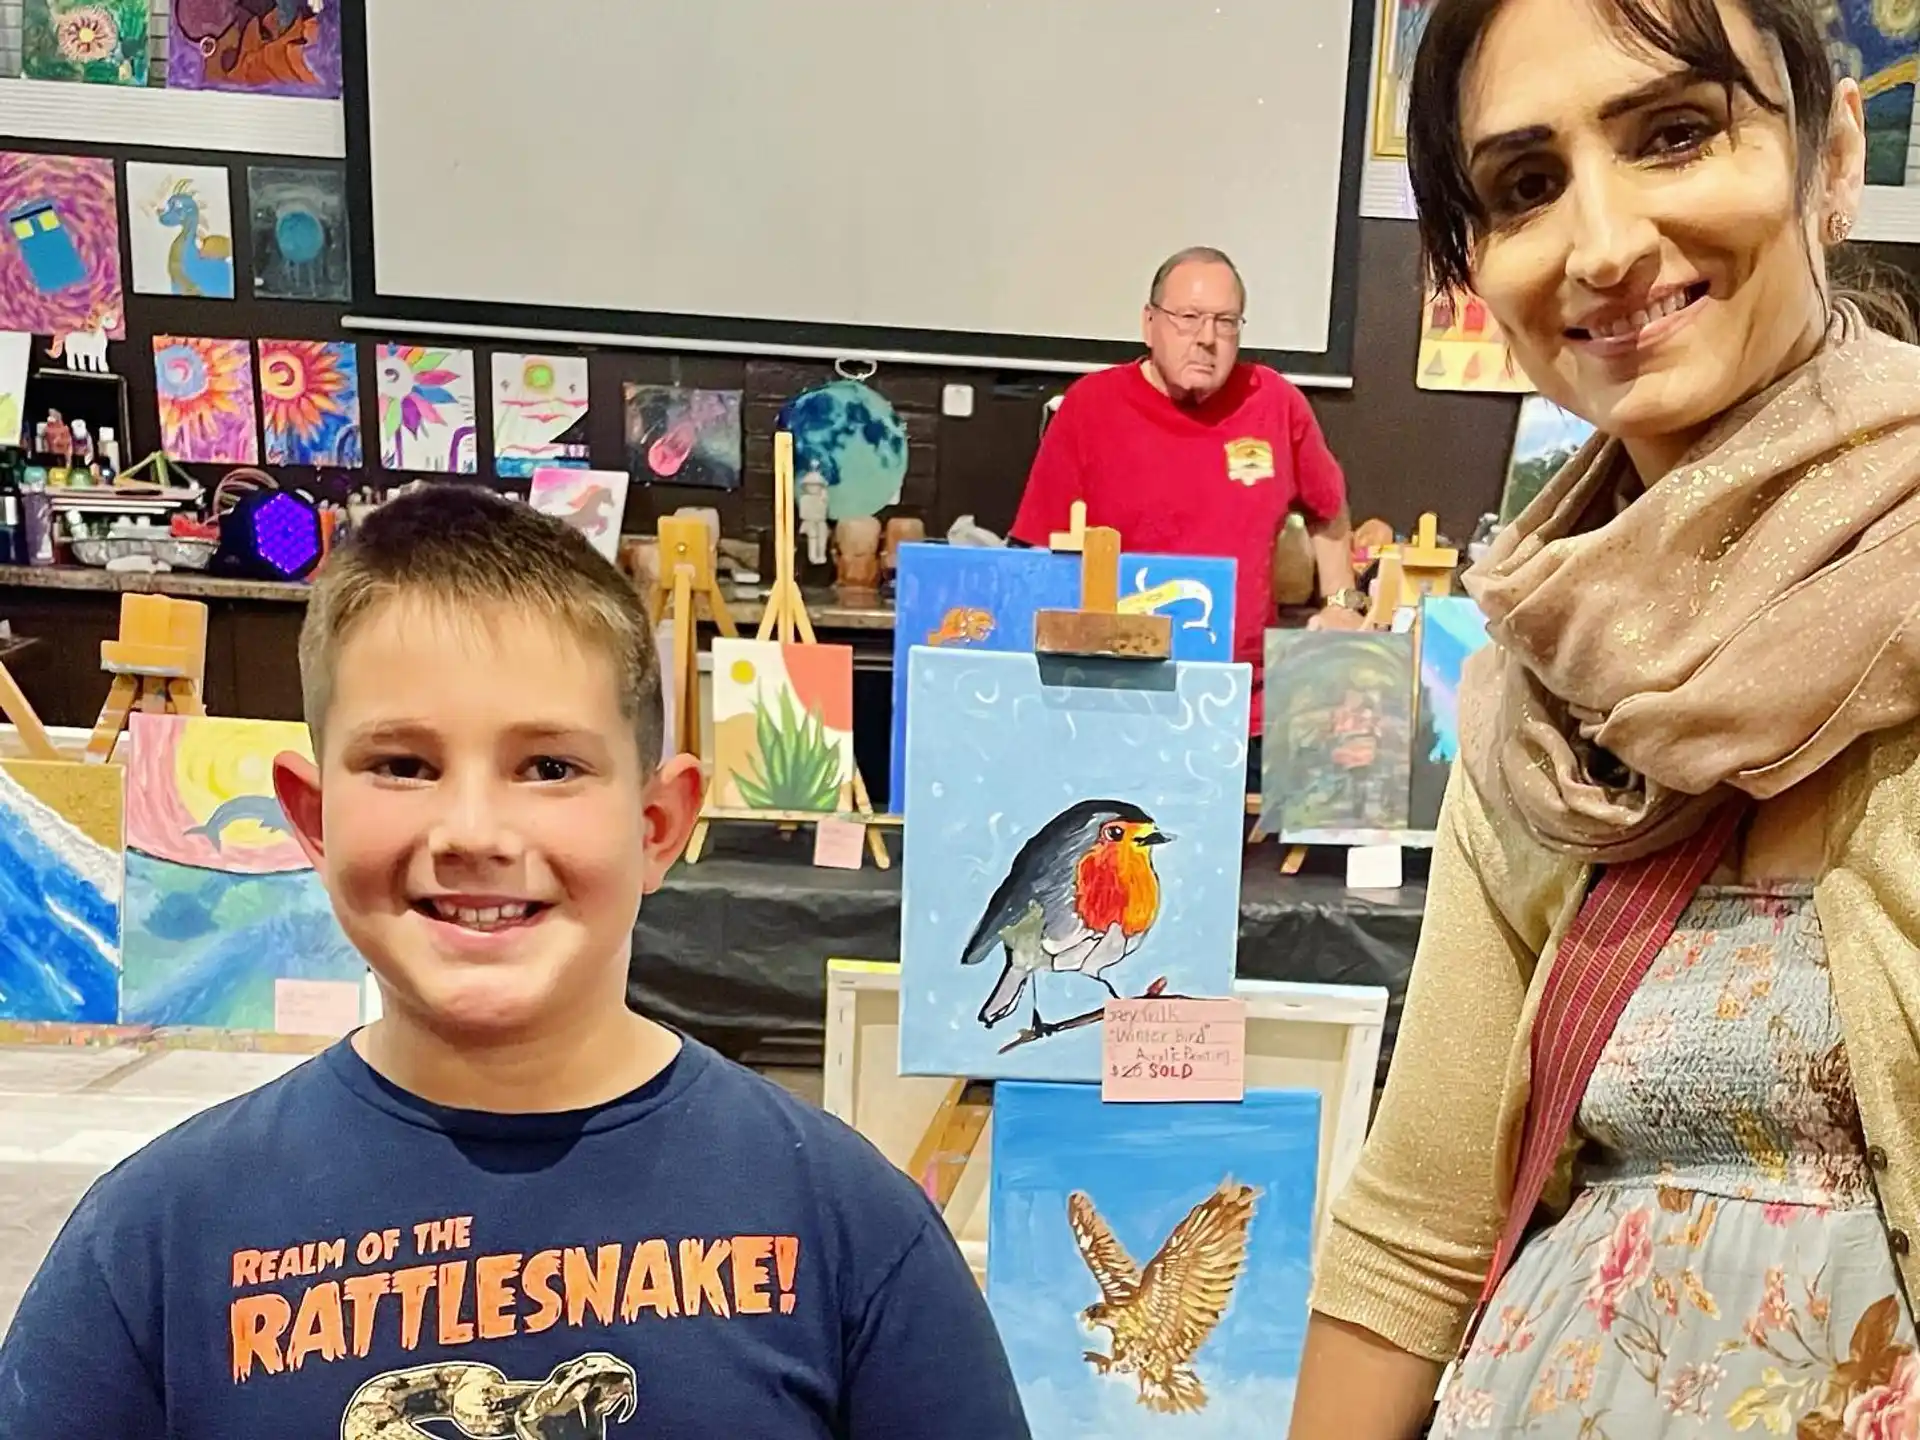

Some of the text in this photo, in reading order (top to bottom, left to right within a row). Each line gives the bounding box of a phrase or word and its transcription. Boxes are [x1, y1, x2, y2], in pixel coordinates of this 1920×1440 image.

[1149, 1062, 1193, 1079] SOLD
[231, 1215, 473, 1288] REALM OF THE
[230, 1235, 799, 1384] RATTLESNAKE!
